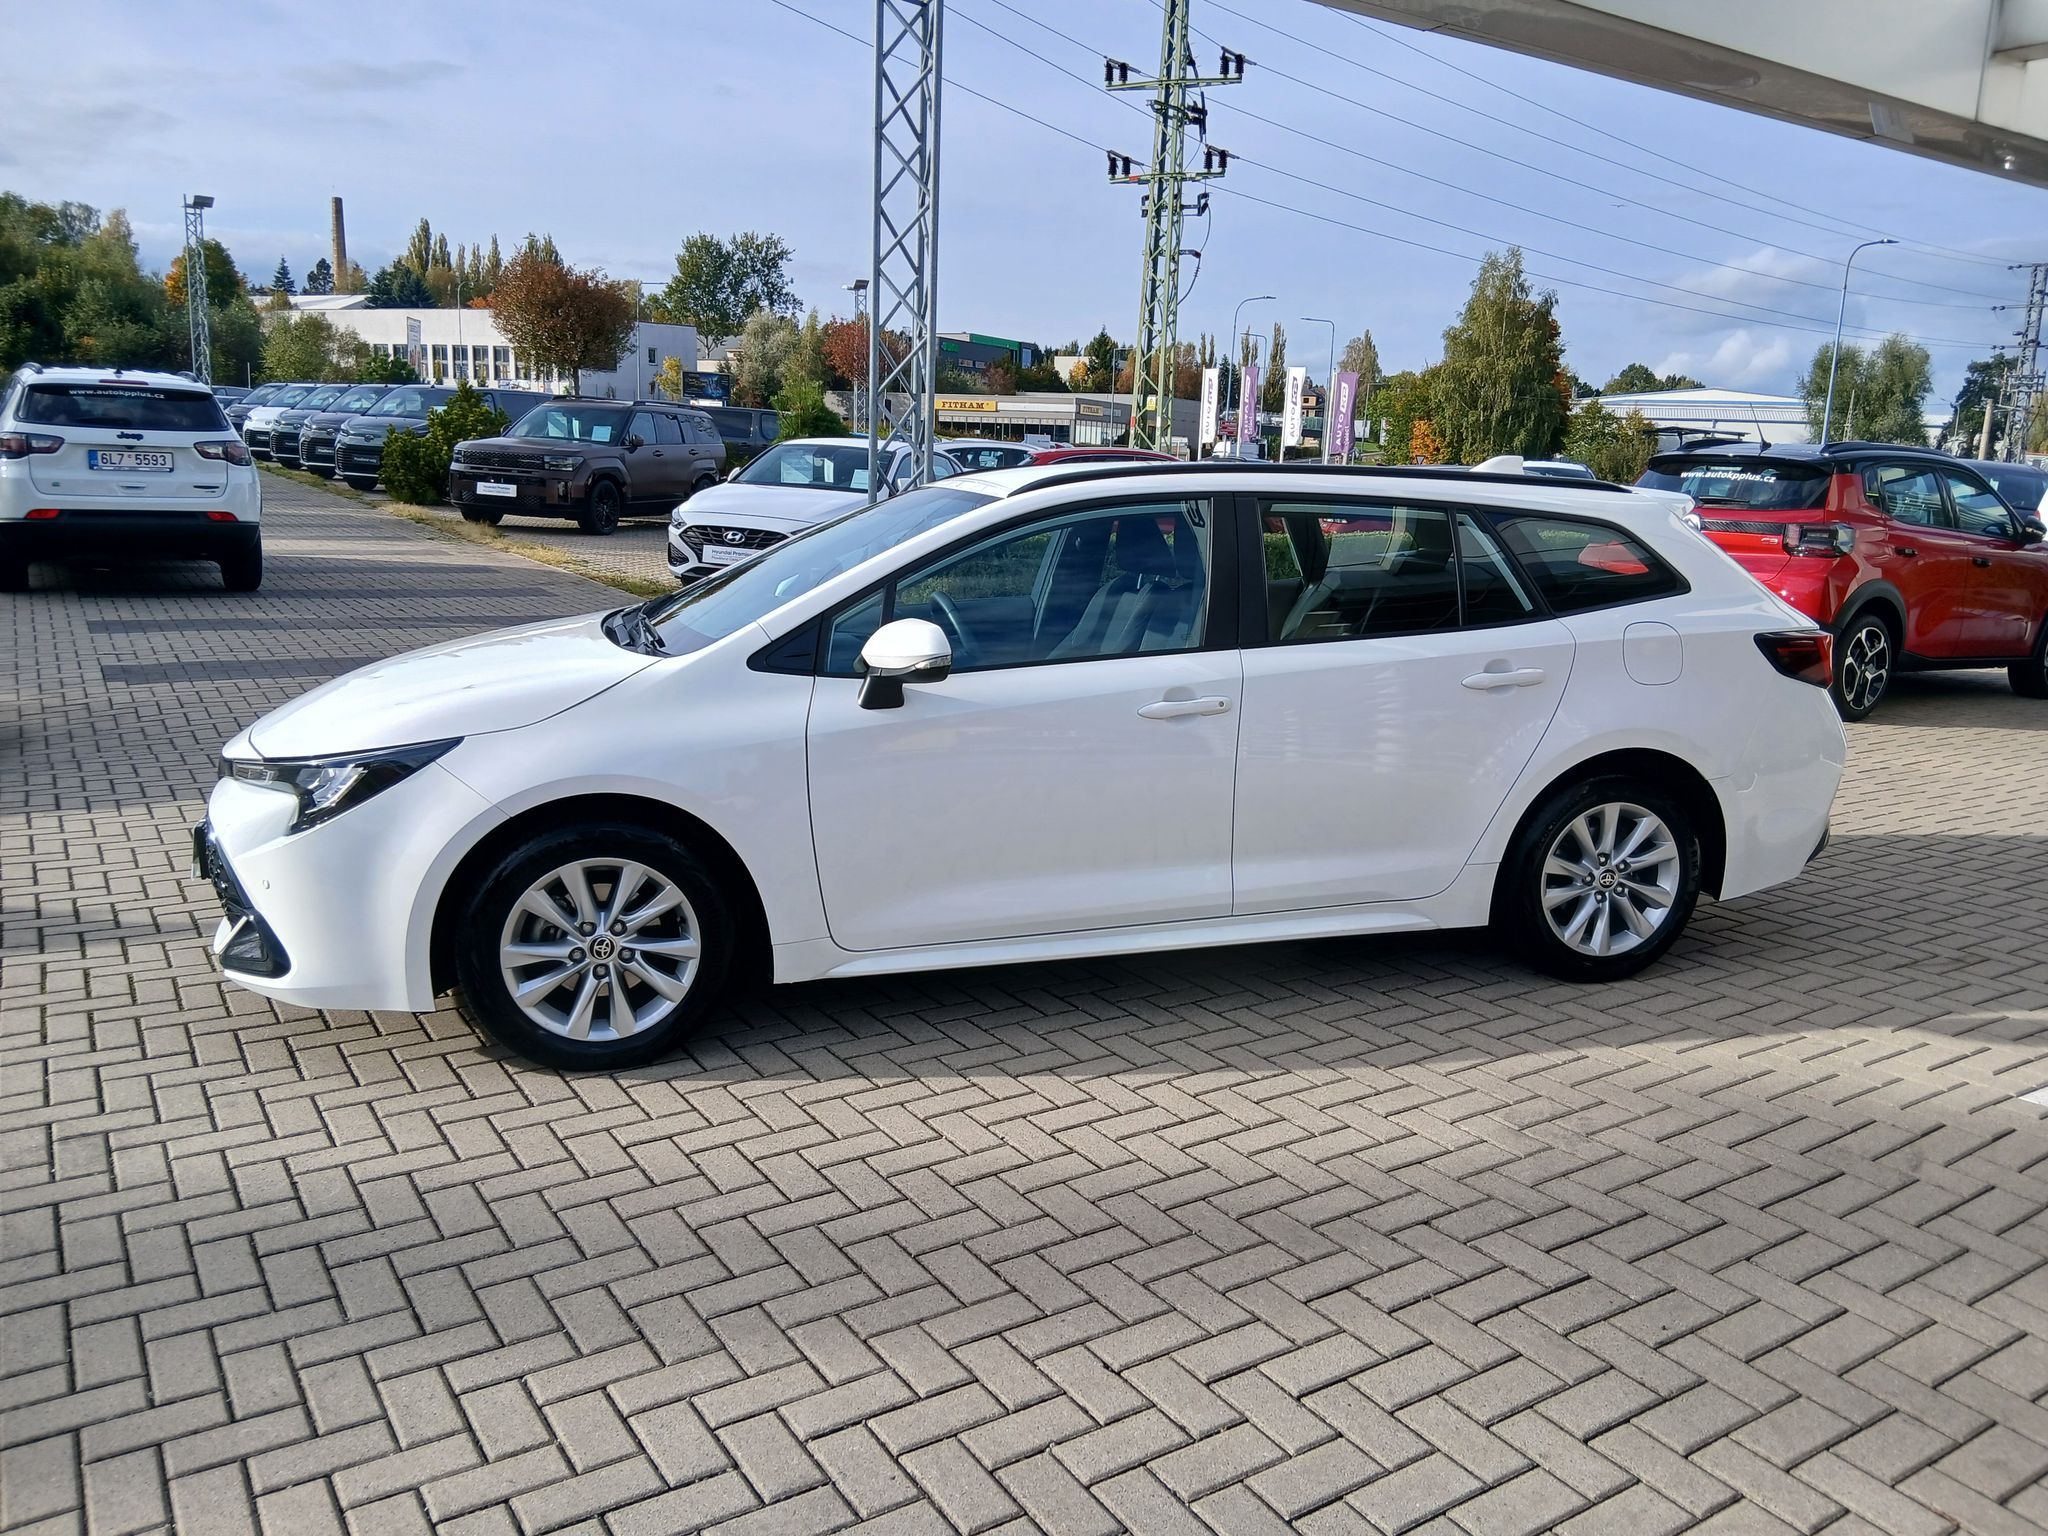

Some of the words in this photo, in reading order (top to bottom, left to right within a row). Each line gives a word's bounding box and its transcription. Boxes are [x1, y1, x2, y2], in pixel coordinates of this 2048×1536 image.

[69, 389, 165, 399] www.autokpplus.cz
[941, 401, 984, 409] FITHAM
[1335, 414, 1344, 446] AUTO
[100, 452, 124, 465] 6L7
[135, 453, 167, 466] 5593
[1681, 470, 1776, 483] www.autokpplus.cz
